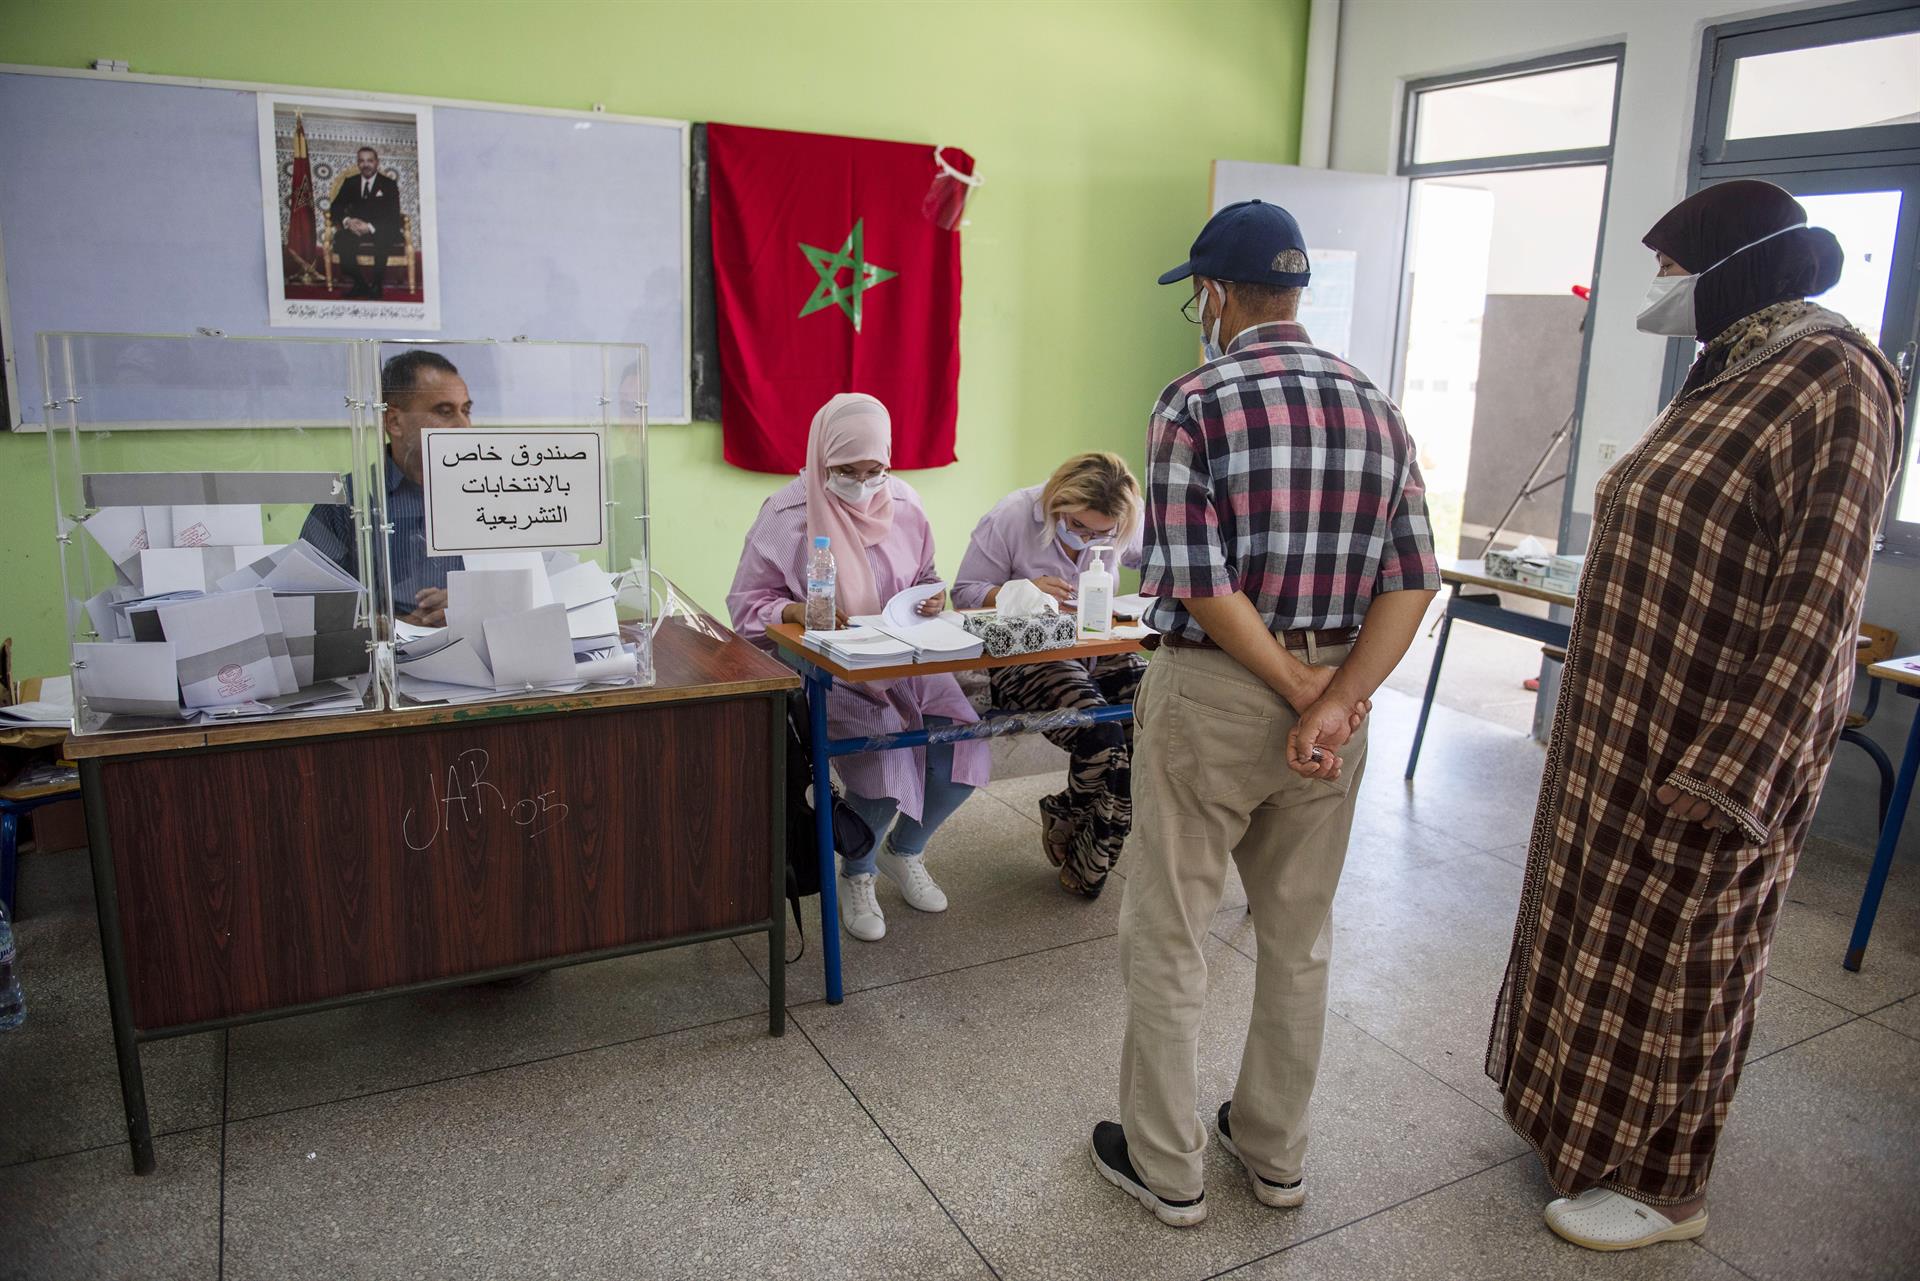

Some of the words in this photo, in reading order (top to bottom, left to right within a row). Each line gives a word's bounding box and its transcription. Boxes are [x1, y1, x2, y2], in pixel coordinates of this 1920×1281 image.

[442, 443, 502, 467] خاص
[511, 444, 587, 467] صندوق
[462, 475, 571, 498] بالانتخابات
[476, 505, 568, 531] التشريعية
